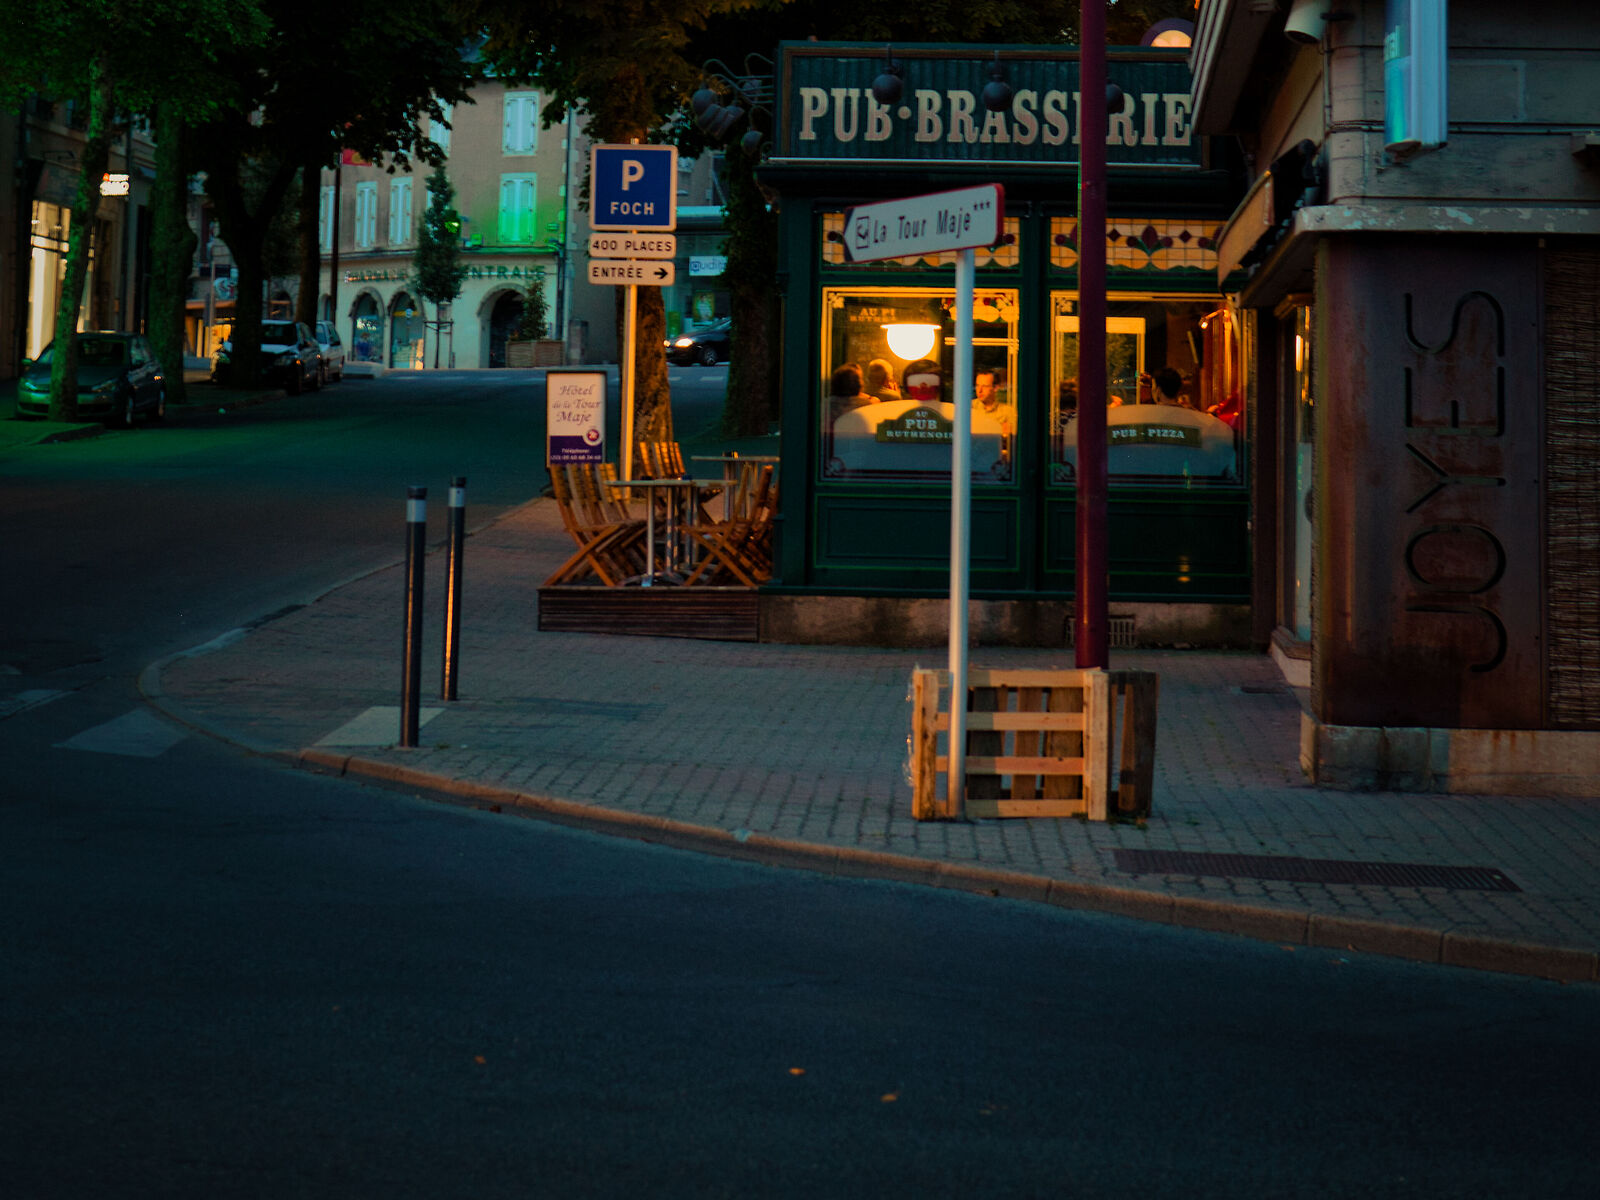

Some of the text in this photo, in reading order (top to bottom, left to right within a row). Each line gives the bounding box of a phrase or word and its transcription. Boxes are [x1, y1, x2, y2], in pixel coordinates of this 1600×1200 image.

[621, 159, 645, 191] P
[609, 201, 655, 216] FOCH
[873, 207, 971, 244] La Tour Maje
[592, 240, 673, 252] 400 PLACES
[559, 384, 595, 396] Hôtel
[573, 399, 602, 409] Tour
[556, 410, 592, 426] Maje
[905, 419, 938, 430] PUB
[886, 430, 953, 439] RUTHENOI
[1111, 428, 1138, 439] PUB
[1146, 428, 1186, 440] PIZZA
[1405, 290, 1507, 673] JOYES
